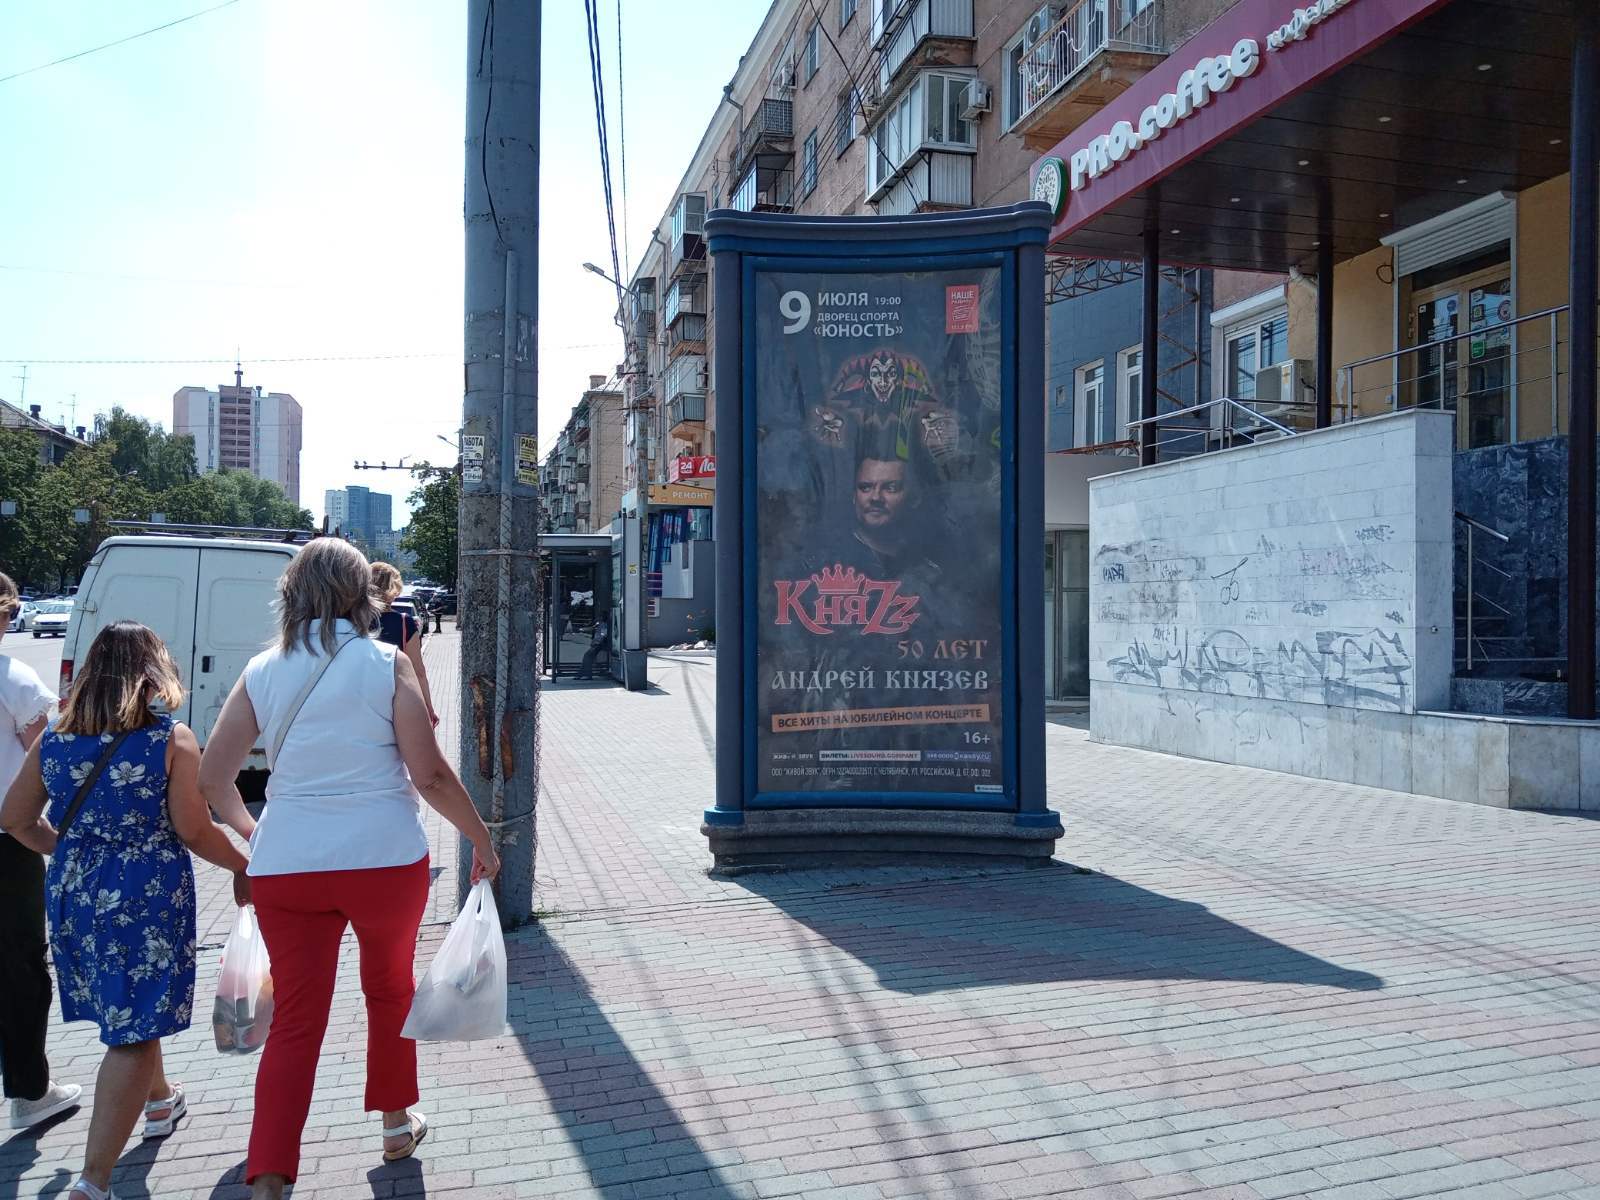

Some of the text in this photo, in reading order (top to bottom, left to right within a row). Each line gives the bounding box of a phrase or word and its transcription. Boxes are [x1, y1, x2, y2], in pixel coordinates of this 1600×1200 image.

[779, 290, 902, 335] 9 ИЮЛЯ 19:00
[817, 311, 900, 323] ДВОРЕЦ СПОРТА
[813, 323, 904, 337] «ЮНОСТЬ»
[680, 461, 693, 470] 24
[672, 490, 708, 500] РЕМОНТ
[897, 639, 988, 659] 50 ЛЕТ
[771, 665, 989, 693] АНДРЕЙ КНЯЗЕВ
[778, 708, 983, 728] ВСЕ ХИТЫ НА ЮБИЛЕЙНОМ КОНЦЕРТЕ
[963, 731, 991, 744] 16+
